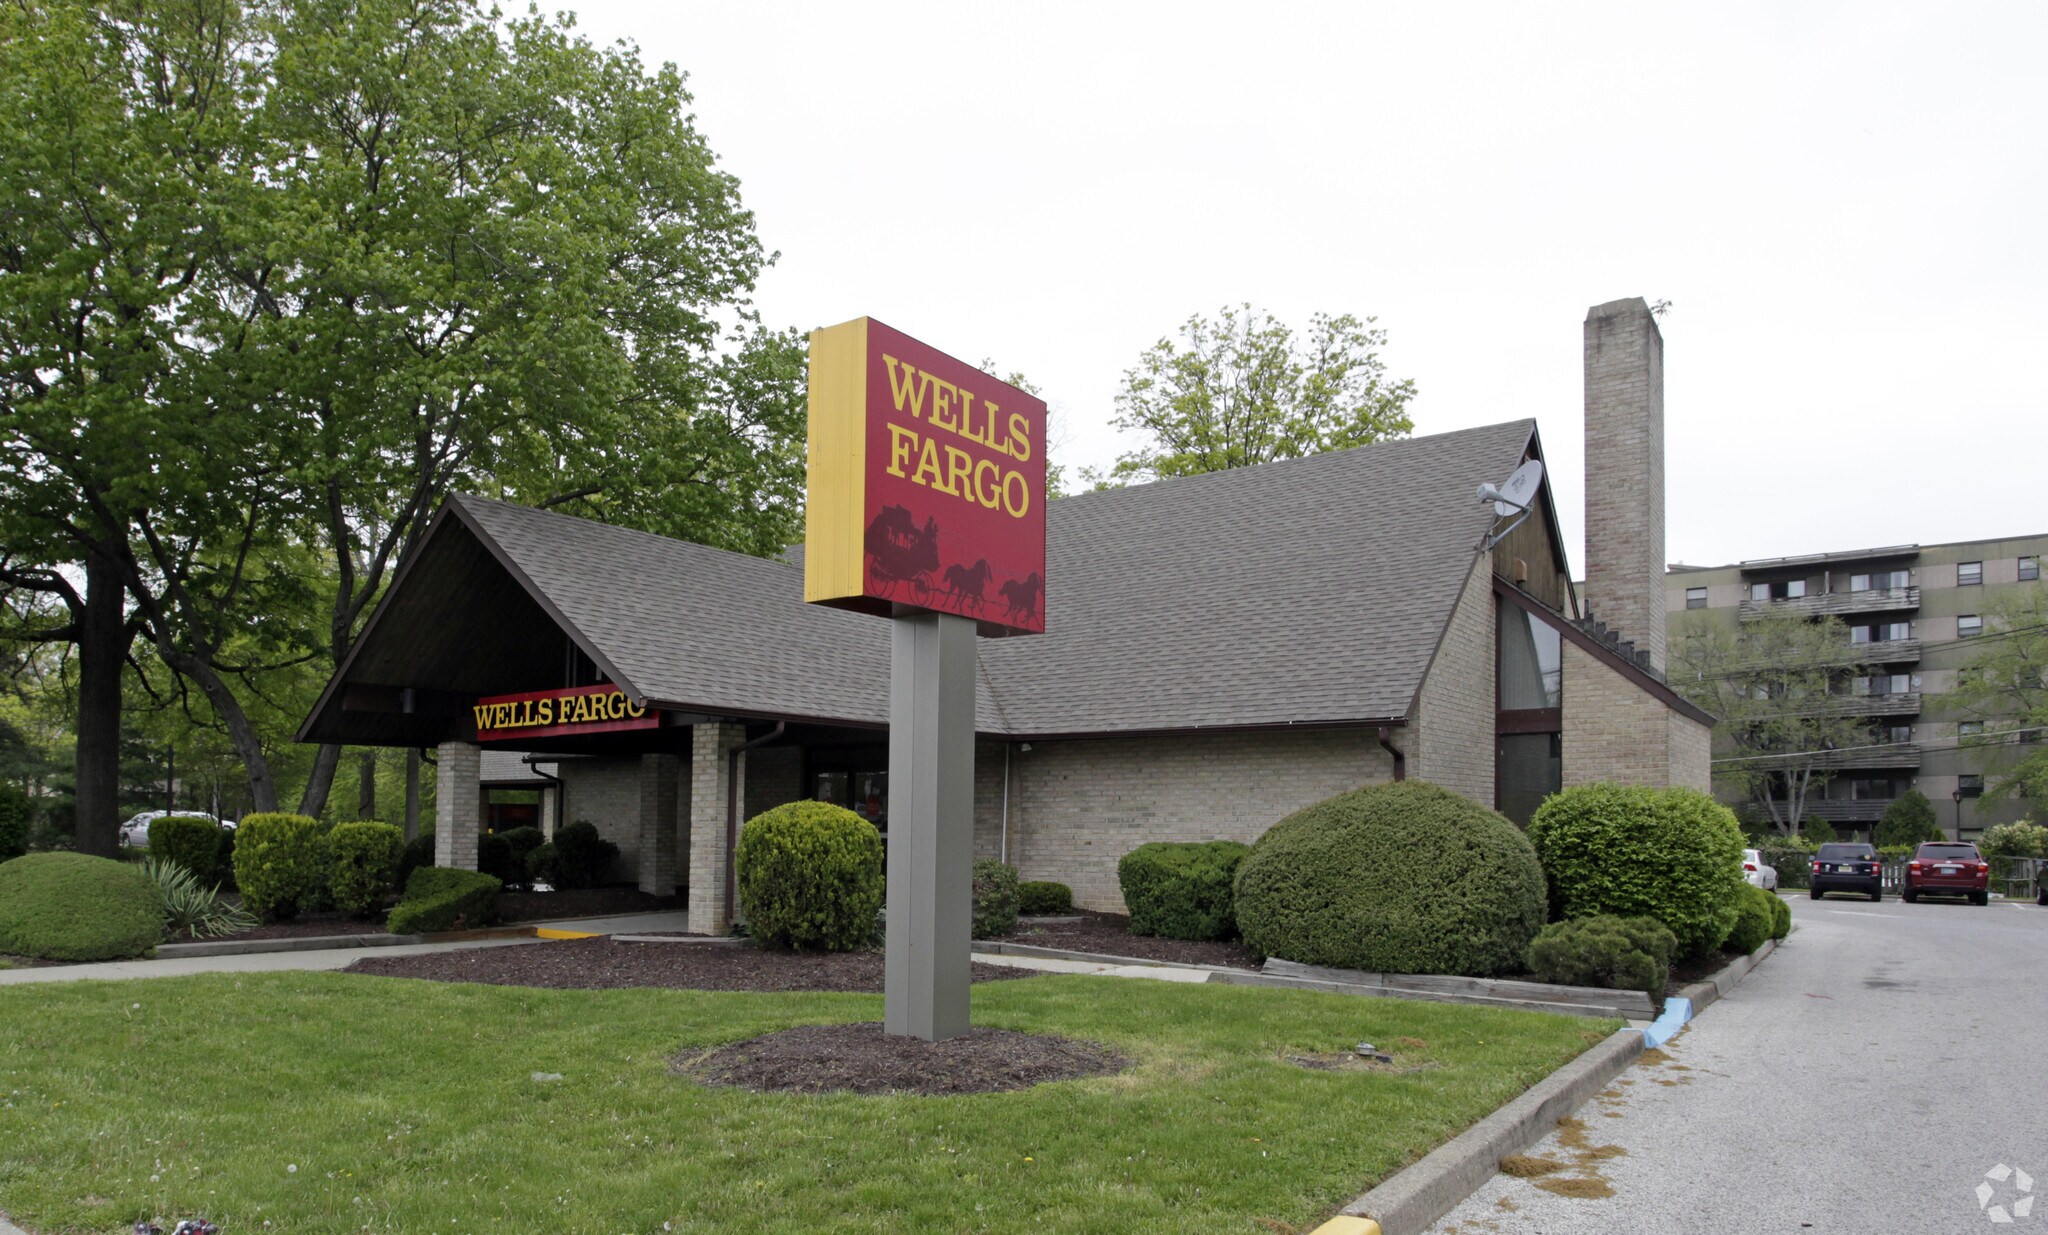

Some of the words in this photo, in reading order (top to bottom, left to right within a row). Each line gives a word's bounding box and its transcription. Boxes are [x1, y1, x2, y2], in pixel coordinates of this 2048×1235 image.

[882, 353, 1031, 462] WELLS
[887, 422, 1029, 518] FARGO
[474, 699, 552, 729] WELLS
